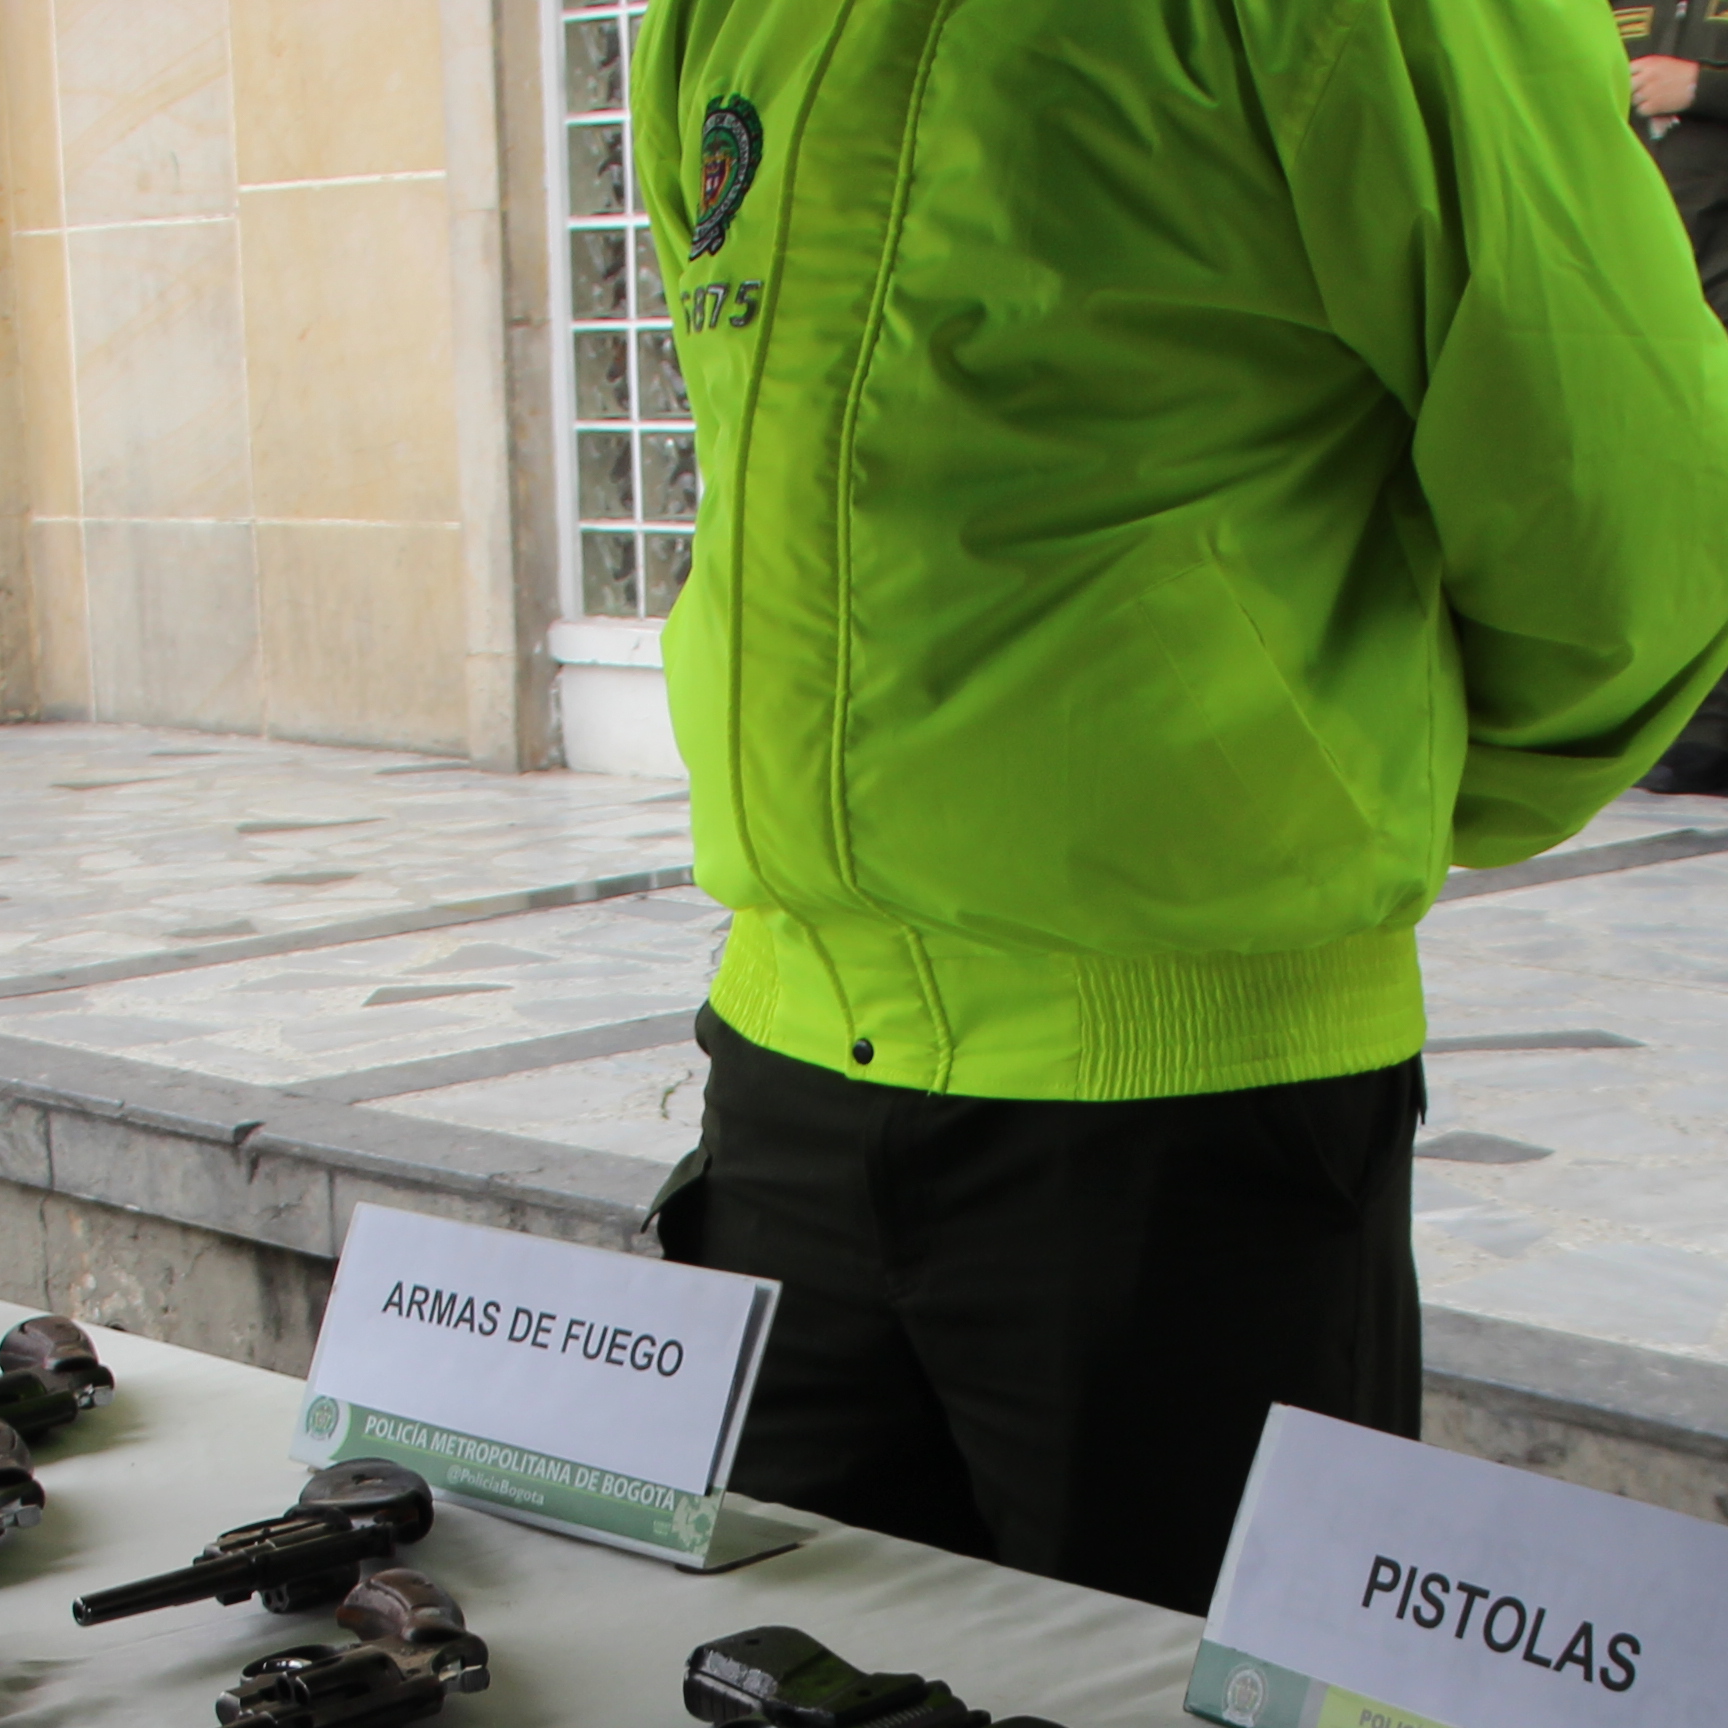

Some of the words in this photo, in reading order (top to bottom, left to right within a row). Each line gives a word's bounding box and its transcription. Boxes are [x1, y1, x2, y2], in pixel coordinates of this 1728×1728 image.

[381, 1280, 501, 1337] ARMAS
[507, 1307, 556, 1349] DE
[560, 1318, 684, 1377] FUEGO
[364, 1415, 427, 1449] POLICÍA
[431, 1432, 571, 1484] METROPOLITANA
[574, 1466, 599, 1491] DE
[447, 1464, 545, 1506] @PoliciaBogota
[1361, 1554, 1642, 1693] PISTOLAS
